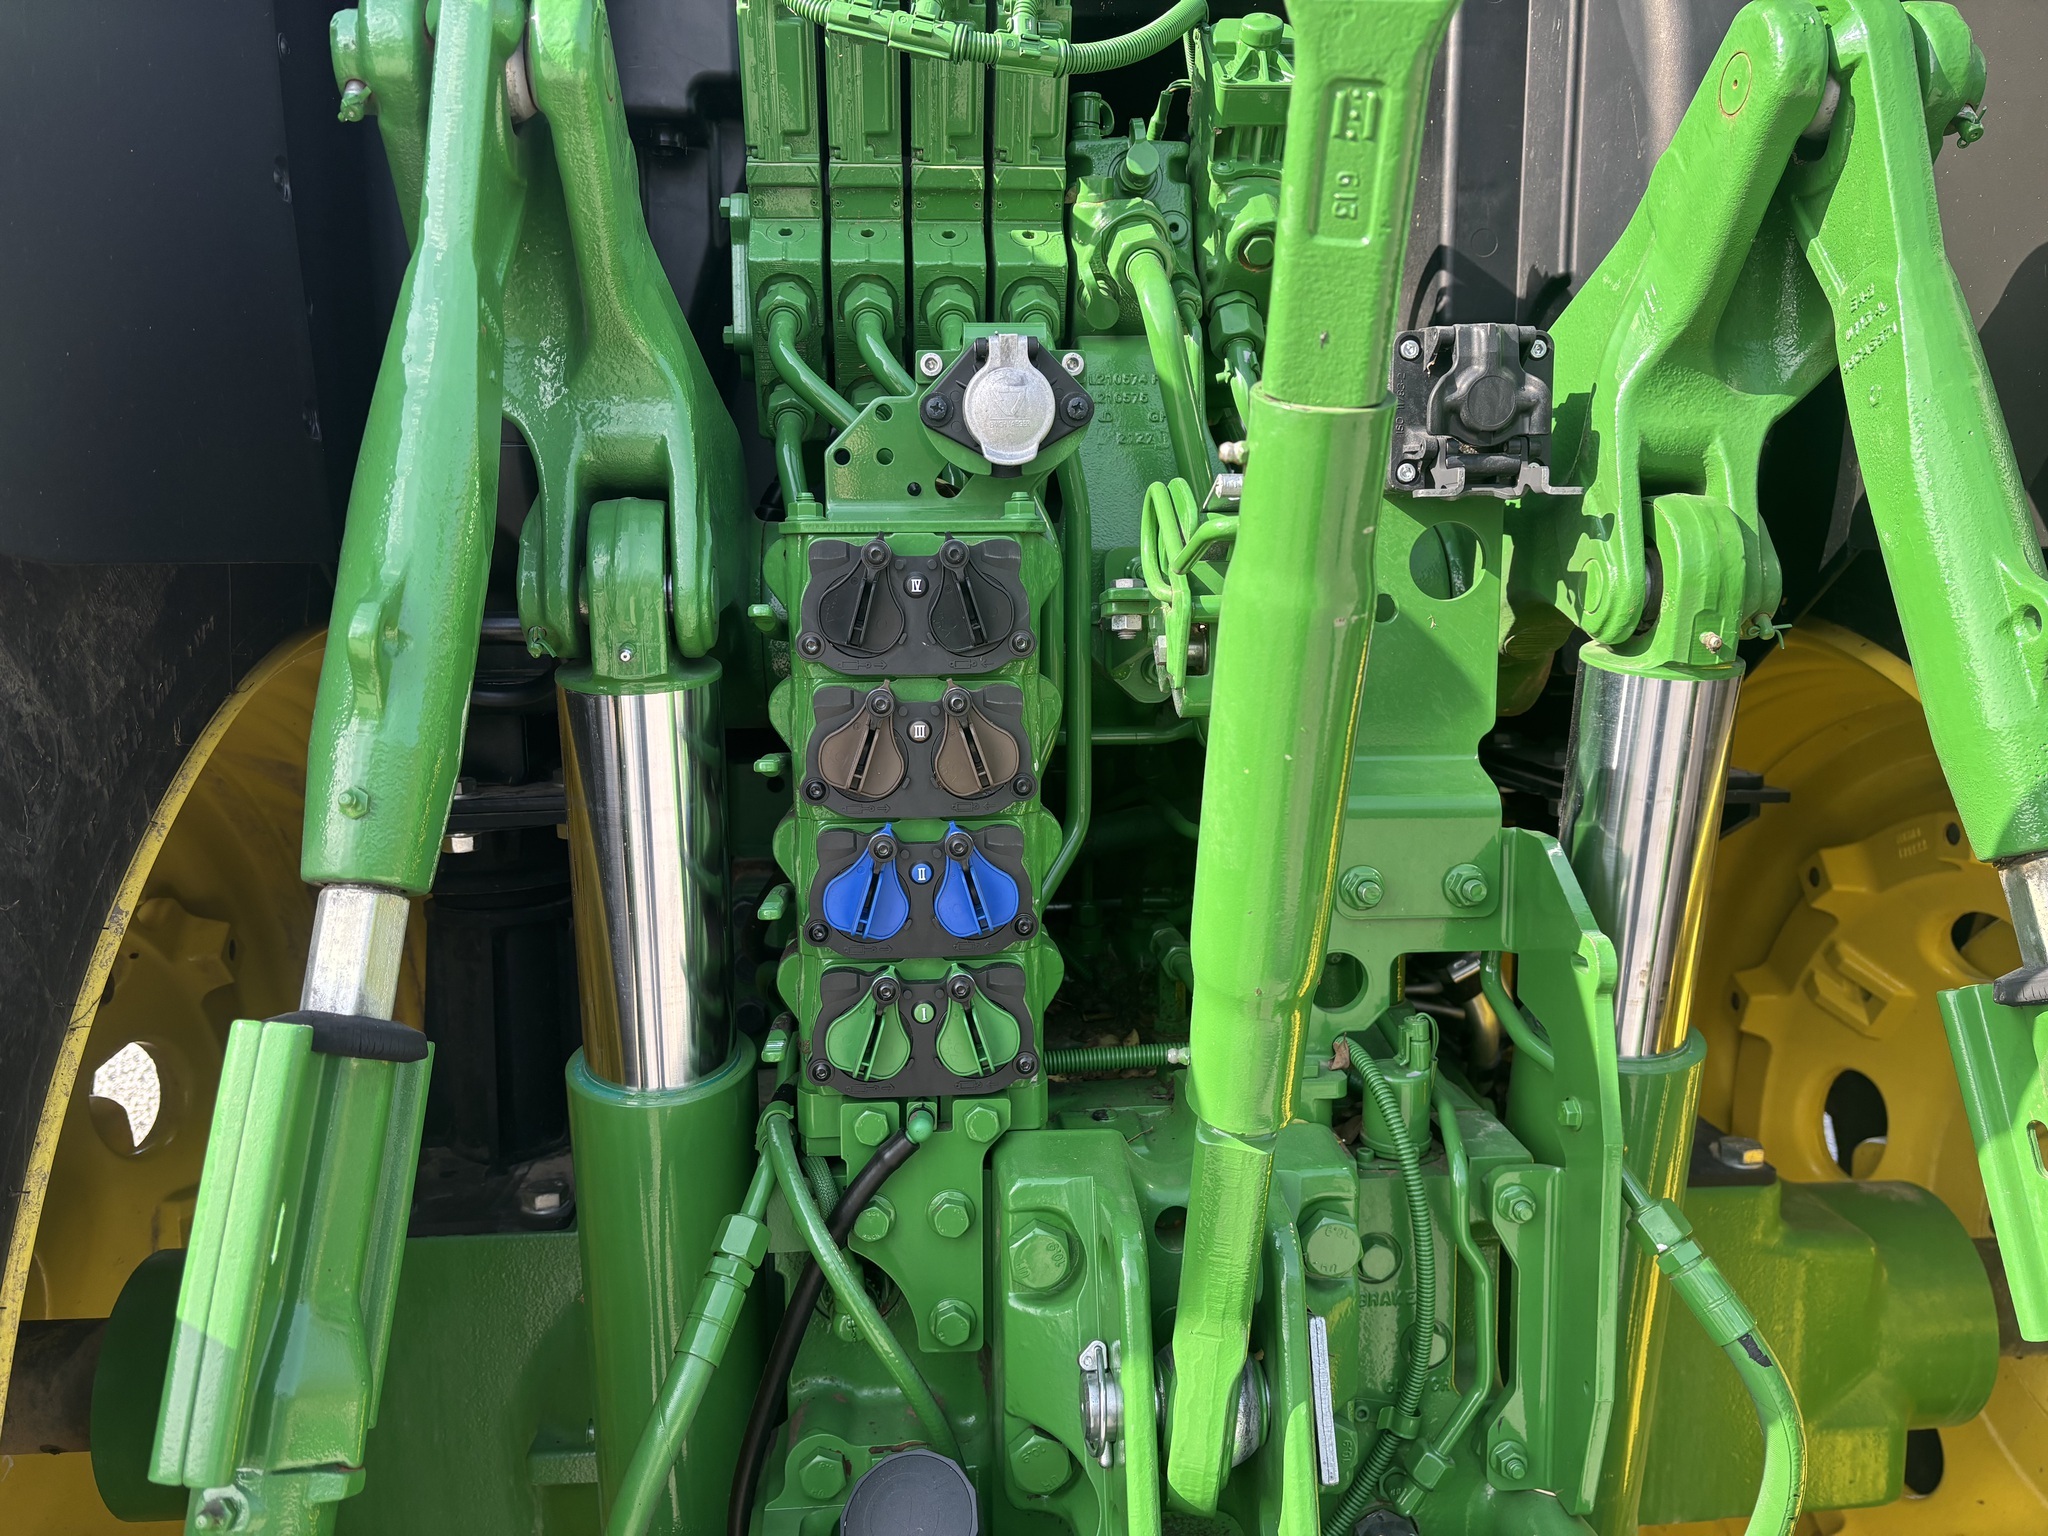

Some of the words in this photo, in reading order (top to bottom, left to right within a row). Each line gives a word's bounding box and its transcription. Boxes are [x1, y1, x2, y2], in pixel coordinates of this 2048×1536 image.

[1088, 373, 1148, 386] L210574
[1396, 416, 1404, 435] ISO
[911, 578, 922, 593] IV
[914, 724, 926, 739] III
[917, 867, 926, 881] II
[921, 1007, 927, 1021] I
[1358, 1288, 1416, 1308] BRAKE
